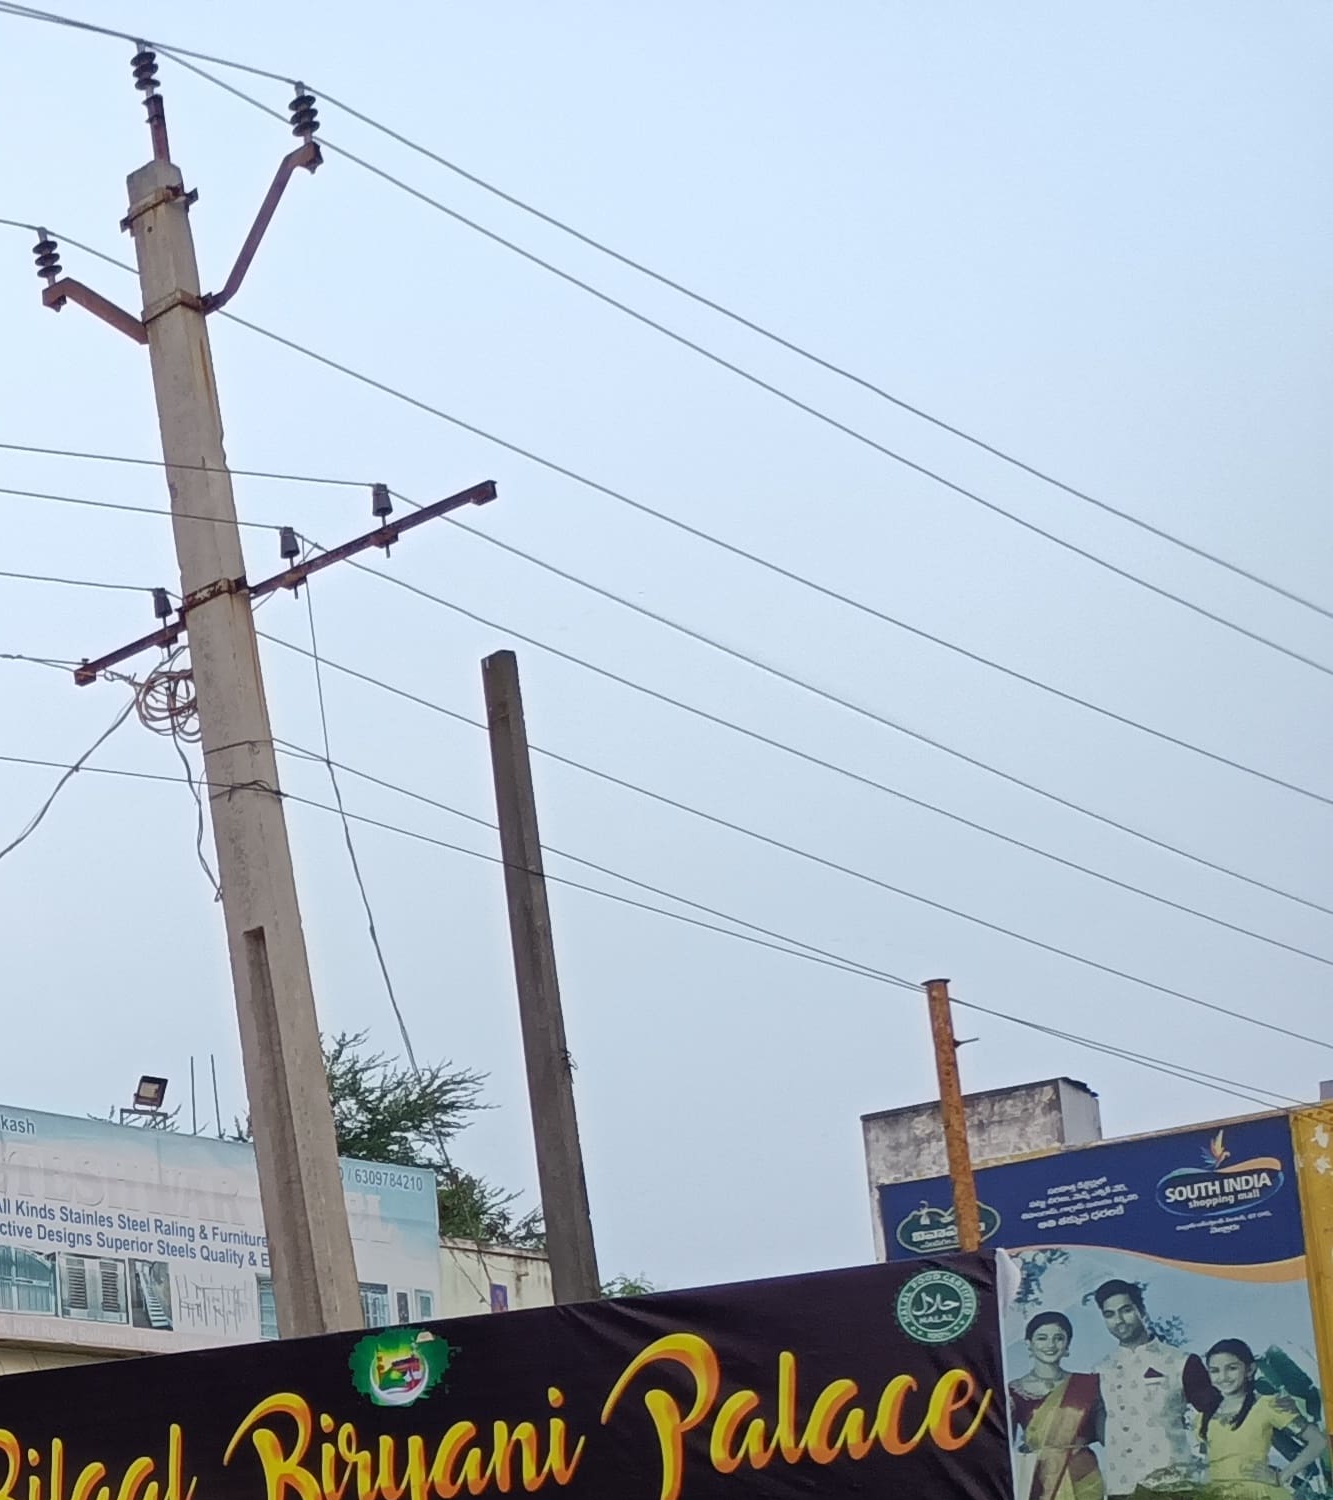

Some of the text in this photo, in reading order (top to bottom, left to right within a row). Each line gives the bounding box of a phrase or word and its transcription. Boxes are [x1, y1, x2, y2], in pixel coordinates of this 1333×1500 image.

[354, 1168, 424, 1191] 6309784210
[1164, 1172, 1273, 1203] SOUTH INDIA
[1188, 1189, 1261, 1209] shopping mall
[15, 1199, 55, 1221] Kinds
[59, 1206, 114, 1228] Stainles
[117, 1212, 151, 1233] Steel
[154, 1217, 195, 1242] Raling
[199, 1224, 209, 1240] &
[37, 1223, 93, 1247] Designs
[96, 1232, 153, 1254] Superior
[157, 1238, 197, 1260] Steels
[200, 1247, 246, 1268] Quality
[248, 1251, 257, 1266] &
[912, 1291, 960, 1316] حلال
